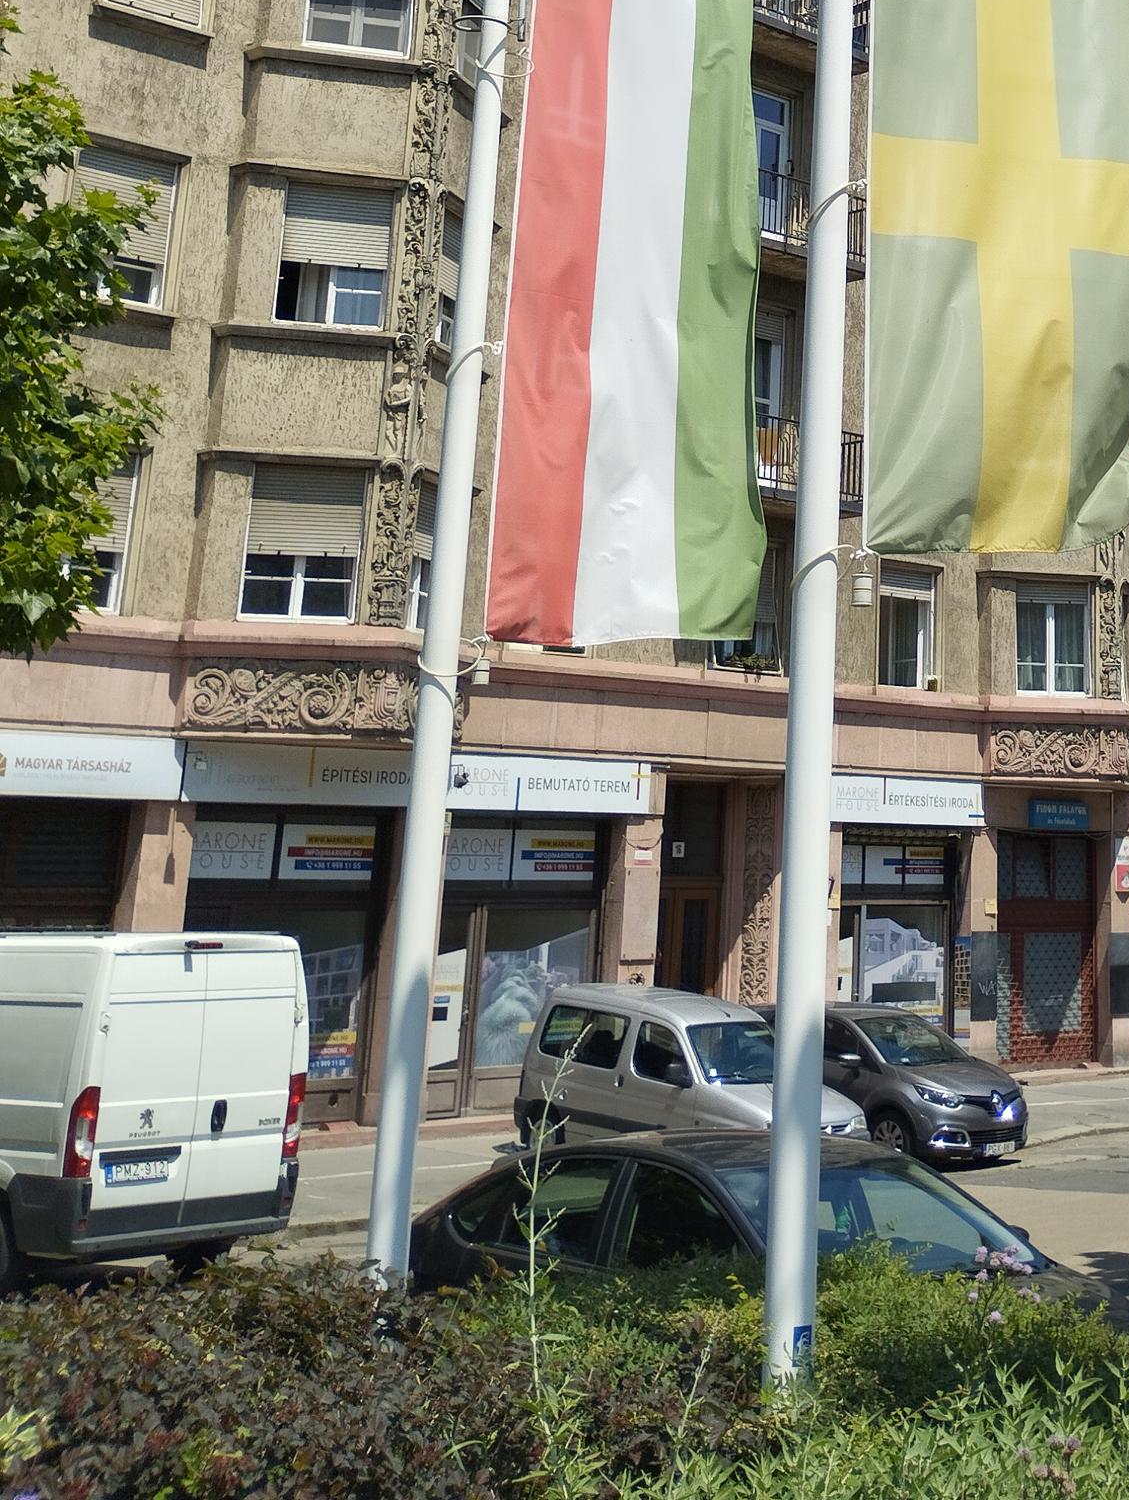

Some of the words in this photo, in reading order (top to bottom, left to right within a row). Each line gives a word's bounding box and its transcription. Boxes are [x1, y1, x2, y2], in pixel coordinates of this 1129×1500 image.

[15, 757, 63, 771] MAGYAR
[66, 756, 133, 774] TÁRSASHÁZ
[321, 766, 372, 784] ÉPÍTÉSI
[528, 777, 590, 792] BEMUTATÓ
[593, 779, 631, 794] TEREM
[836, 786, 879, 798] MARONE
[835, 802, 879, 812] HOUSE
[888, 792, 947, 808] ÉRTÉKESÍTÉSI
[949, 797, 974, 808] IRODA
[448, 837, 504, 853] ARONE
[194, 853, 264, 869] OUSE
[448, 857, 503, 871] OUSE
